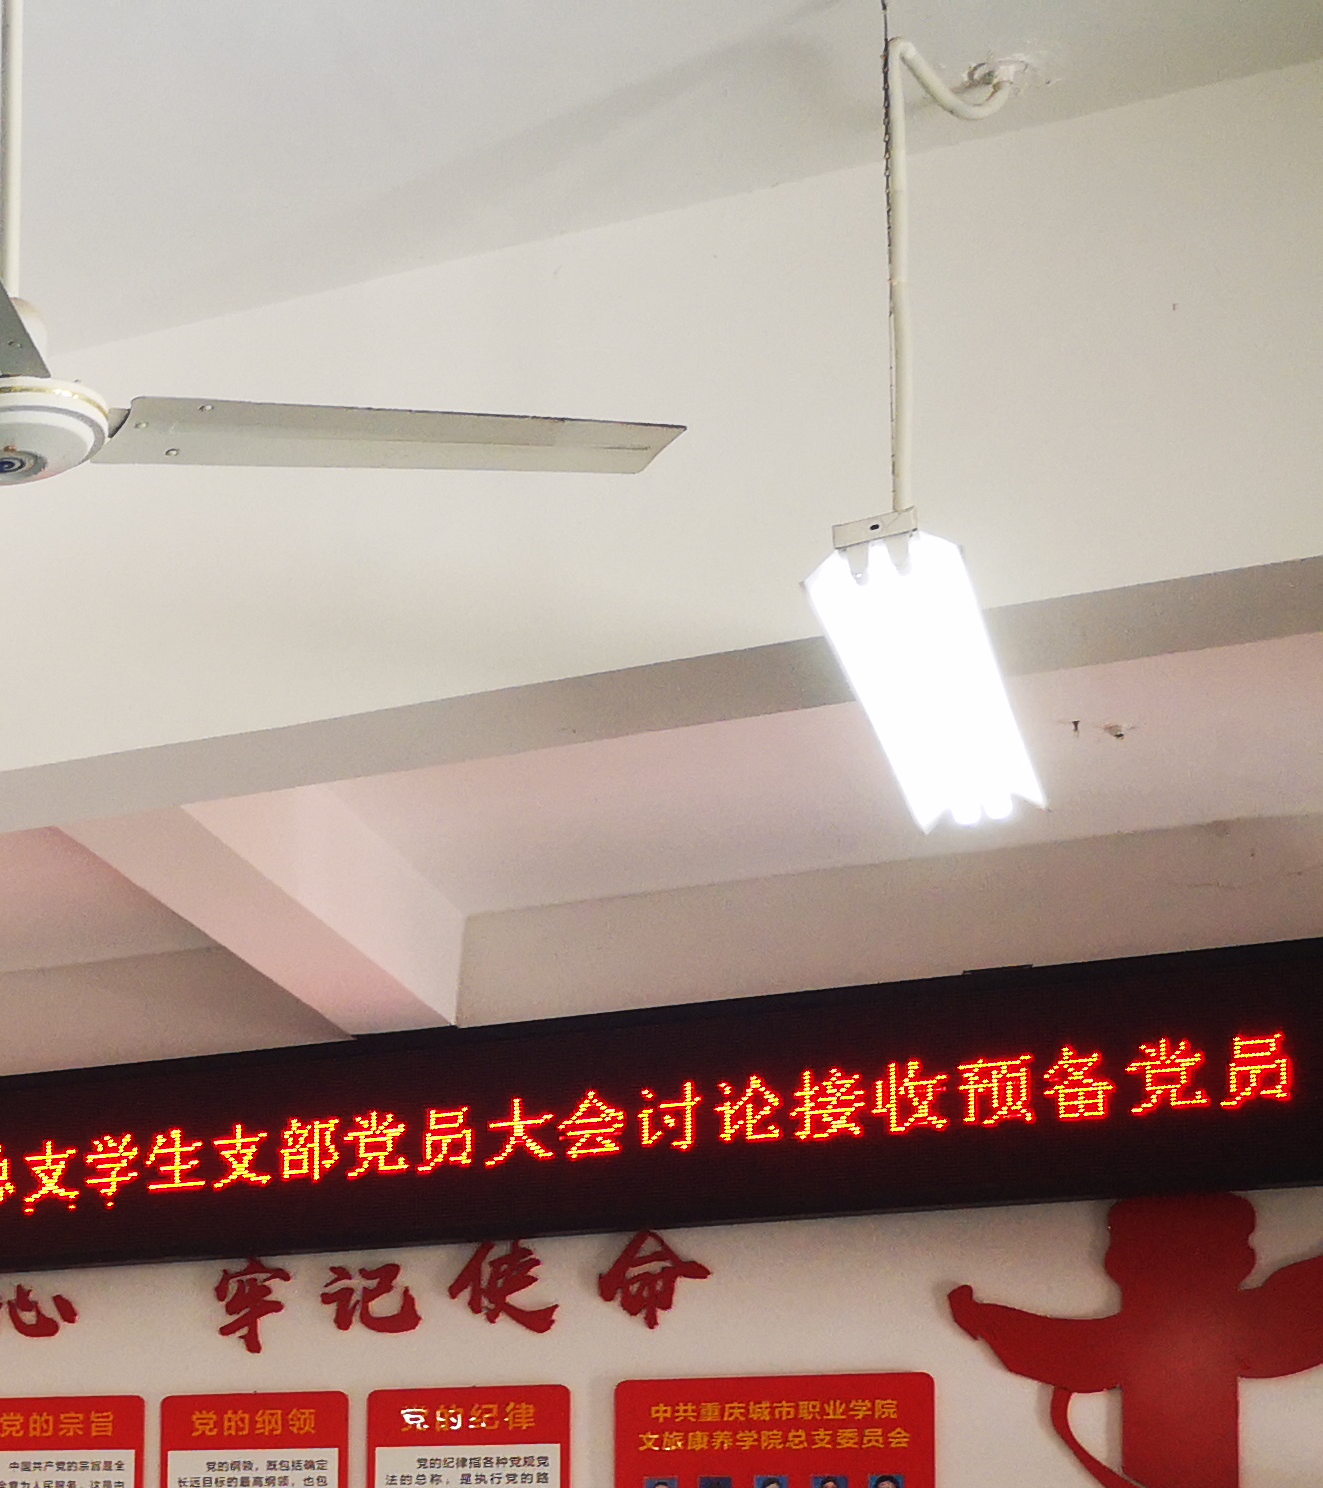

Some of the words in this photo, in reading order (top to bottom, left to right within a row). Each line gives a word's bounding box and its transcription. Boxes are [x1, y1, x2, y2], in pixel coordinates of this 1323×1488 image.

[213, 1228, 711, 1355] 牢记使命
[192, 1408, 316, 1437] 党的纲领
[401, 1402, 535, 1431] 党的纪律
[650, 1399, 898, 1422] 中共重庆城市职业学院
[0, 1411, 114, 1437] 党的宗旨
[639, 1427, 911, 1450] 文旅康养学院总支委员会
[9, 1461, 125, 1472] 中国共产党的宗旨是全
